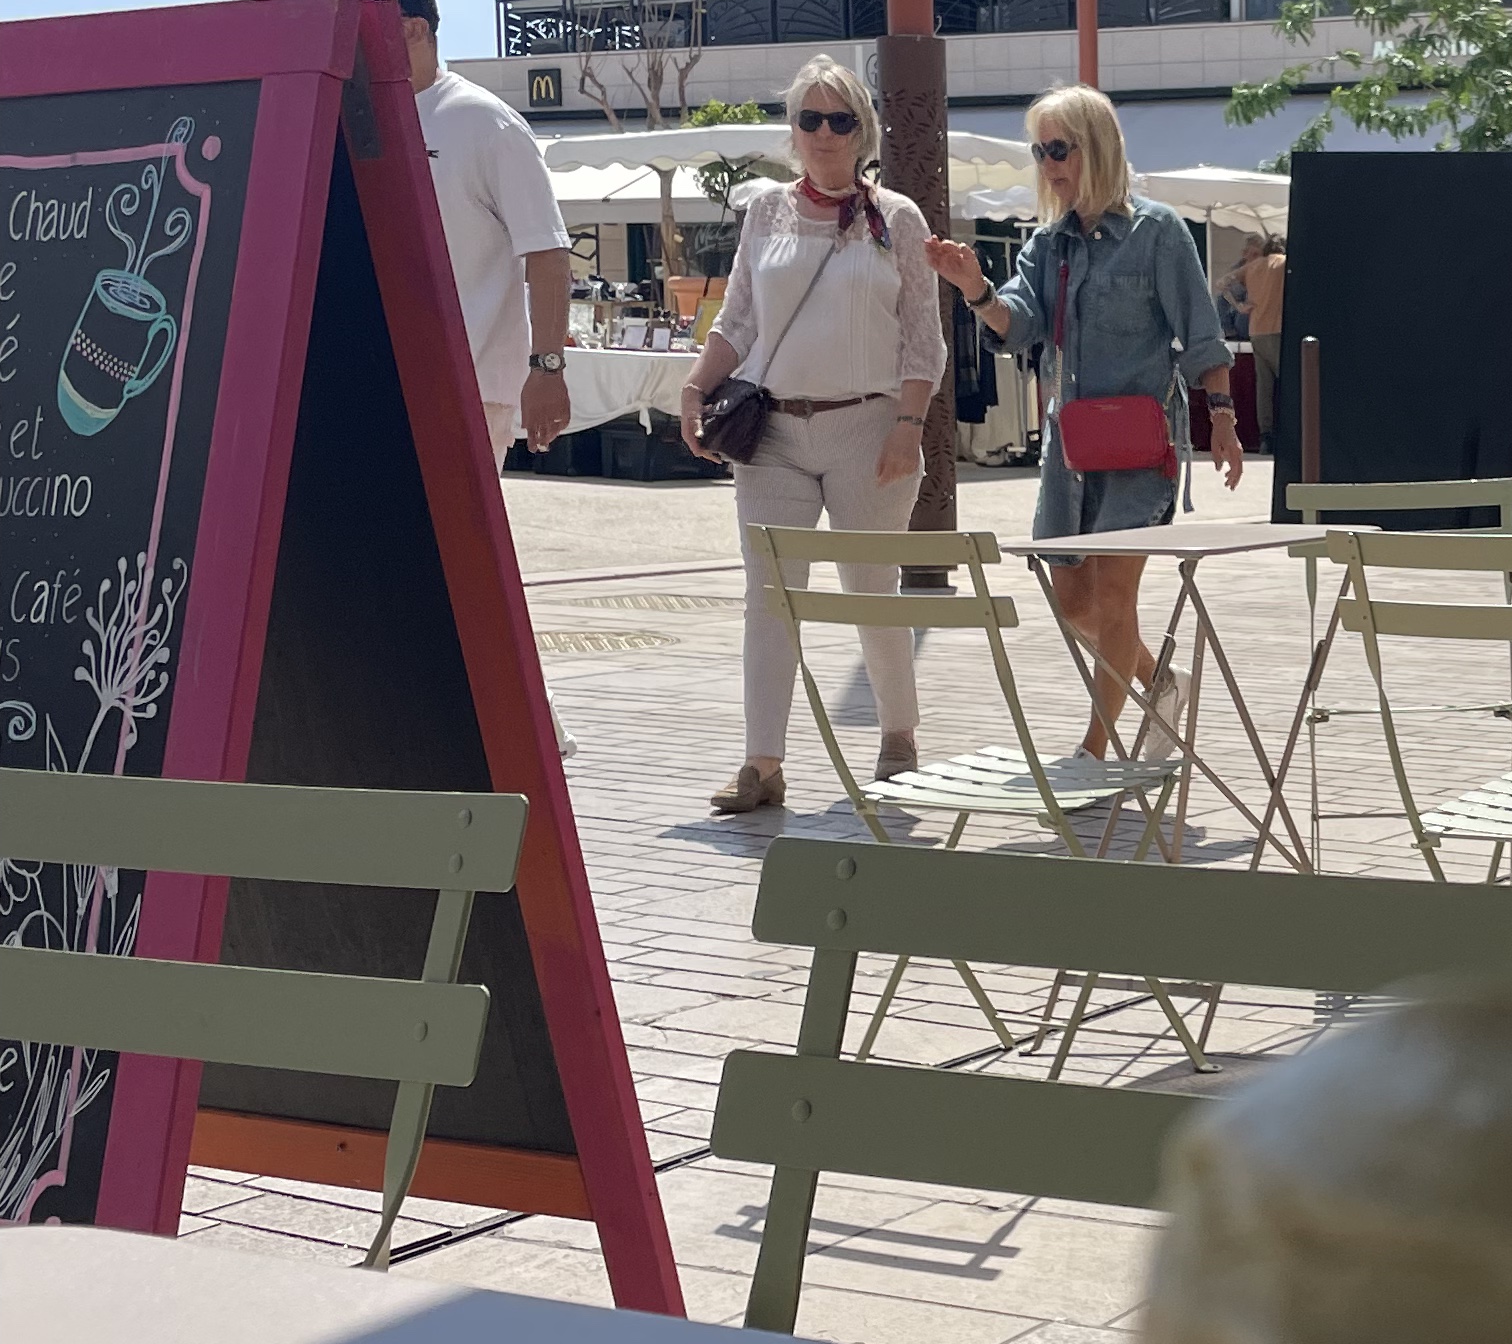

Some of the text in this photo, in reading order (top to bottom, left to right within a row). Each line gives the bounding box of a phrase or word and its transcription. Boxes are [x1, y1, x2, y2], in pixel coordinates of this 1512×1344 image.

[9, 187, 93, 242] Chaud
[10, 405, 44, 460] et
[10, 568, 82, 624] Café
